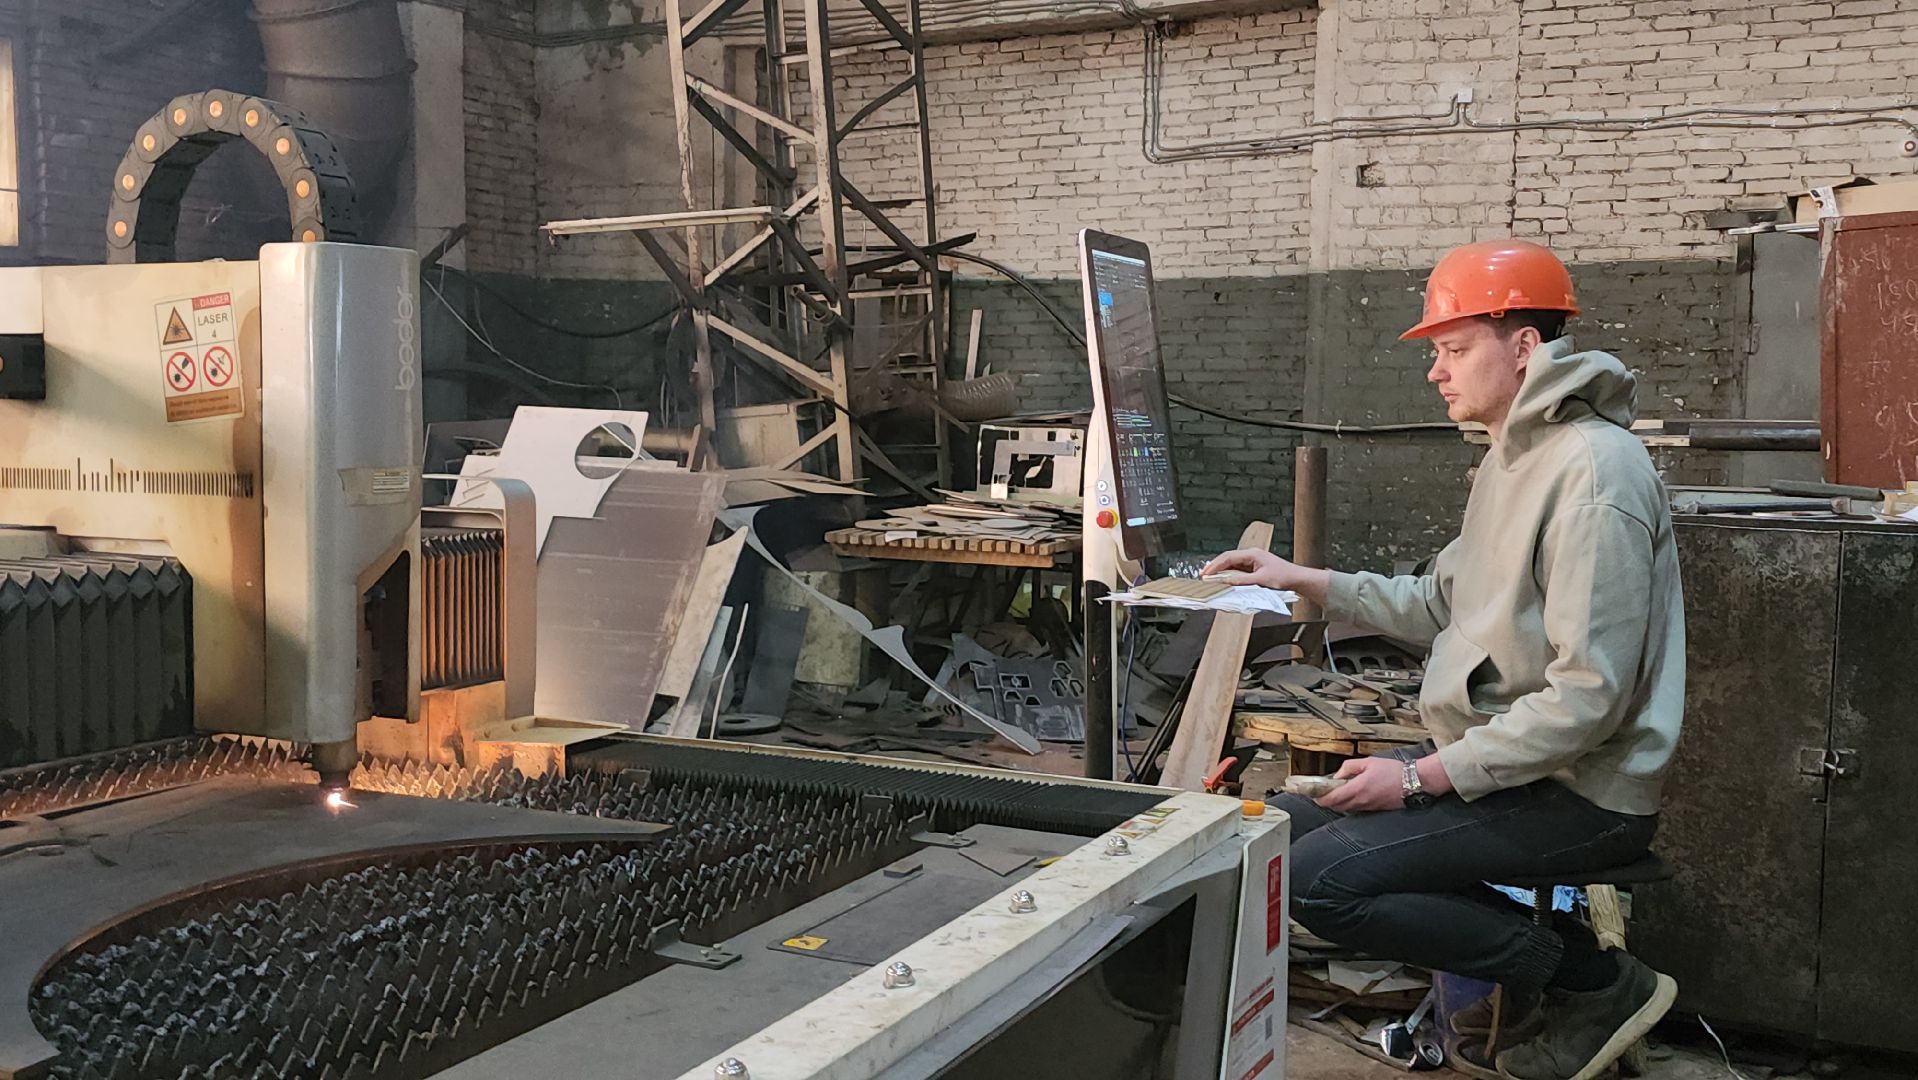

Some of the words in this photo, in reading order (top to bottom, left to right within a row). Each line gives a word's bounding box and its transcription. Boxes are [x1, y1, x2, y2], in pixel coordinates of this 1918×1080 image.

[200, 294, 230, 308] DANGER
[197, 312, 229, 327] LASER
[393, 285, 416, 391] bodor
